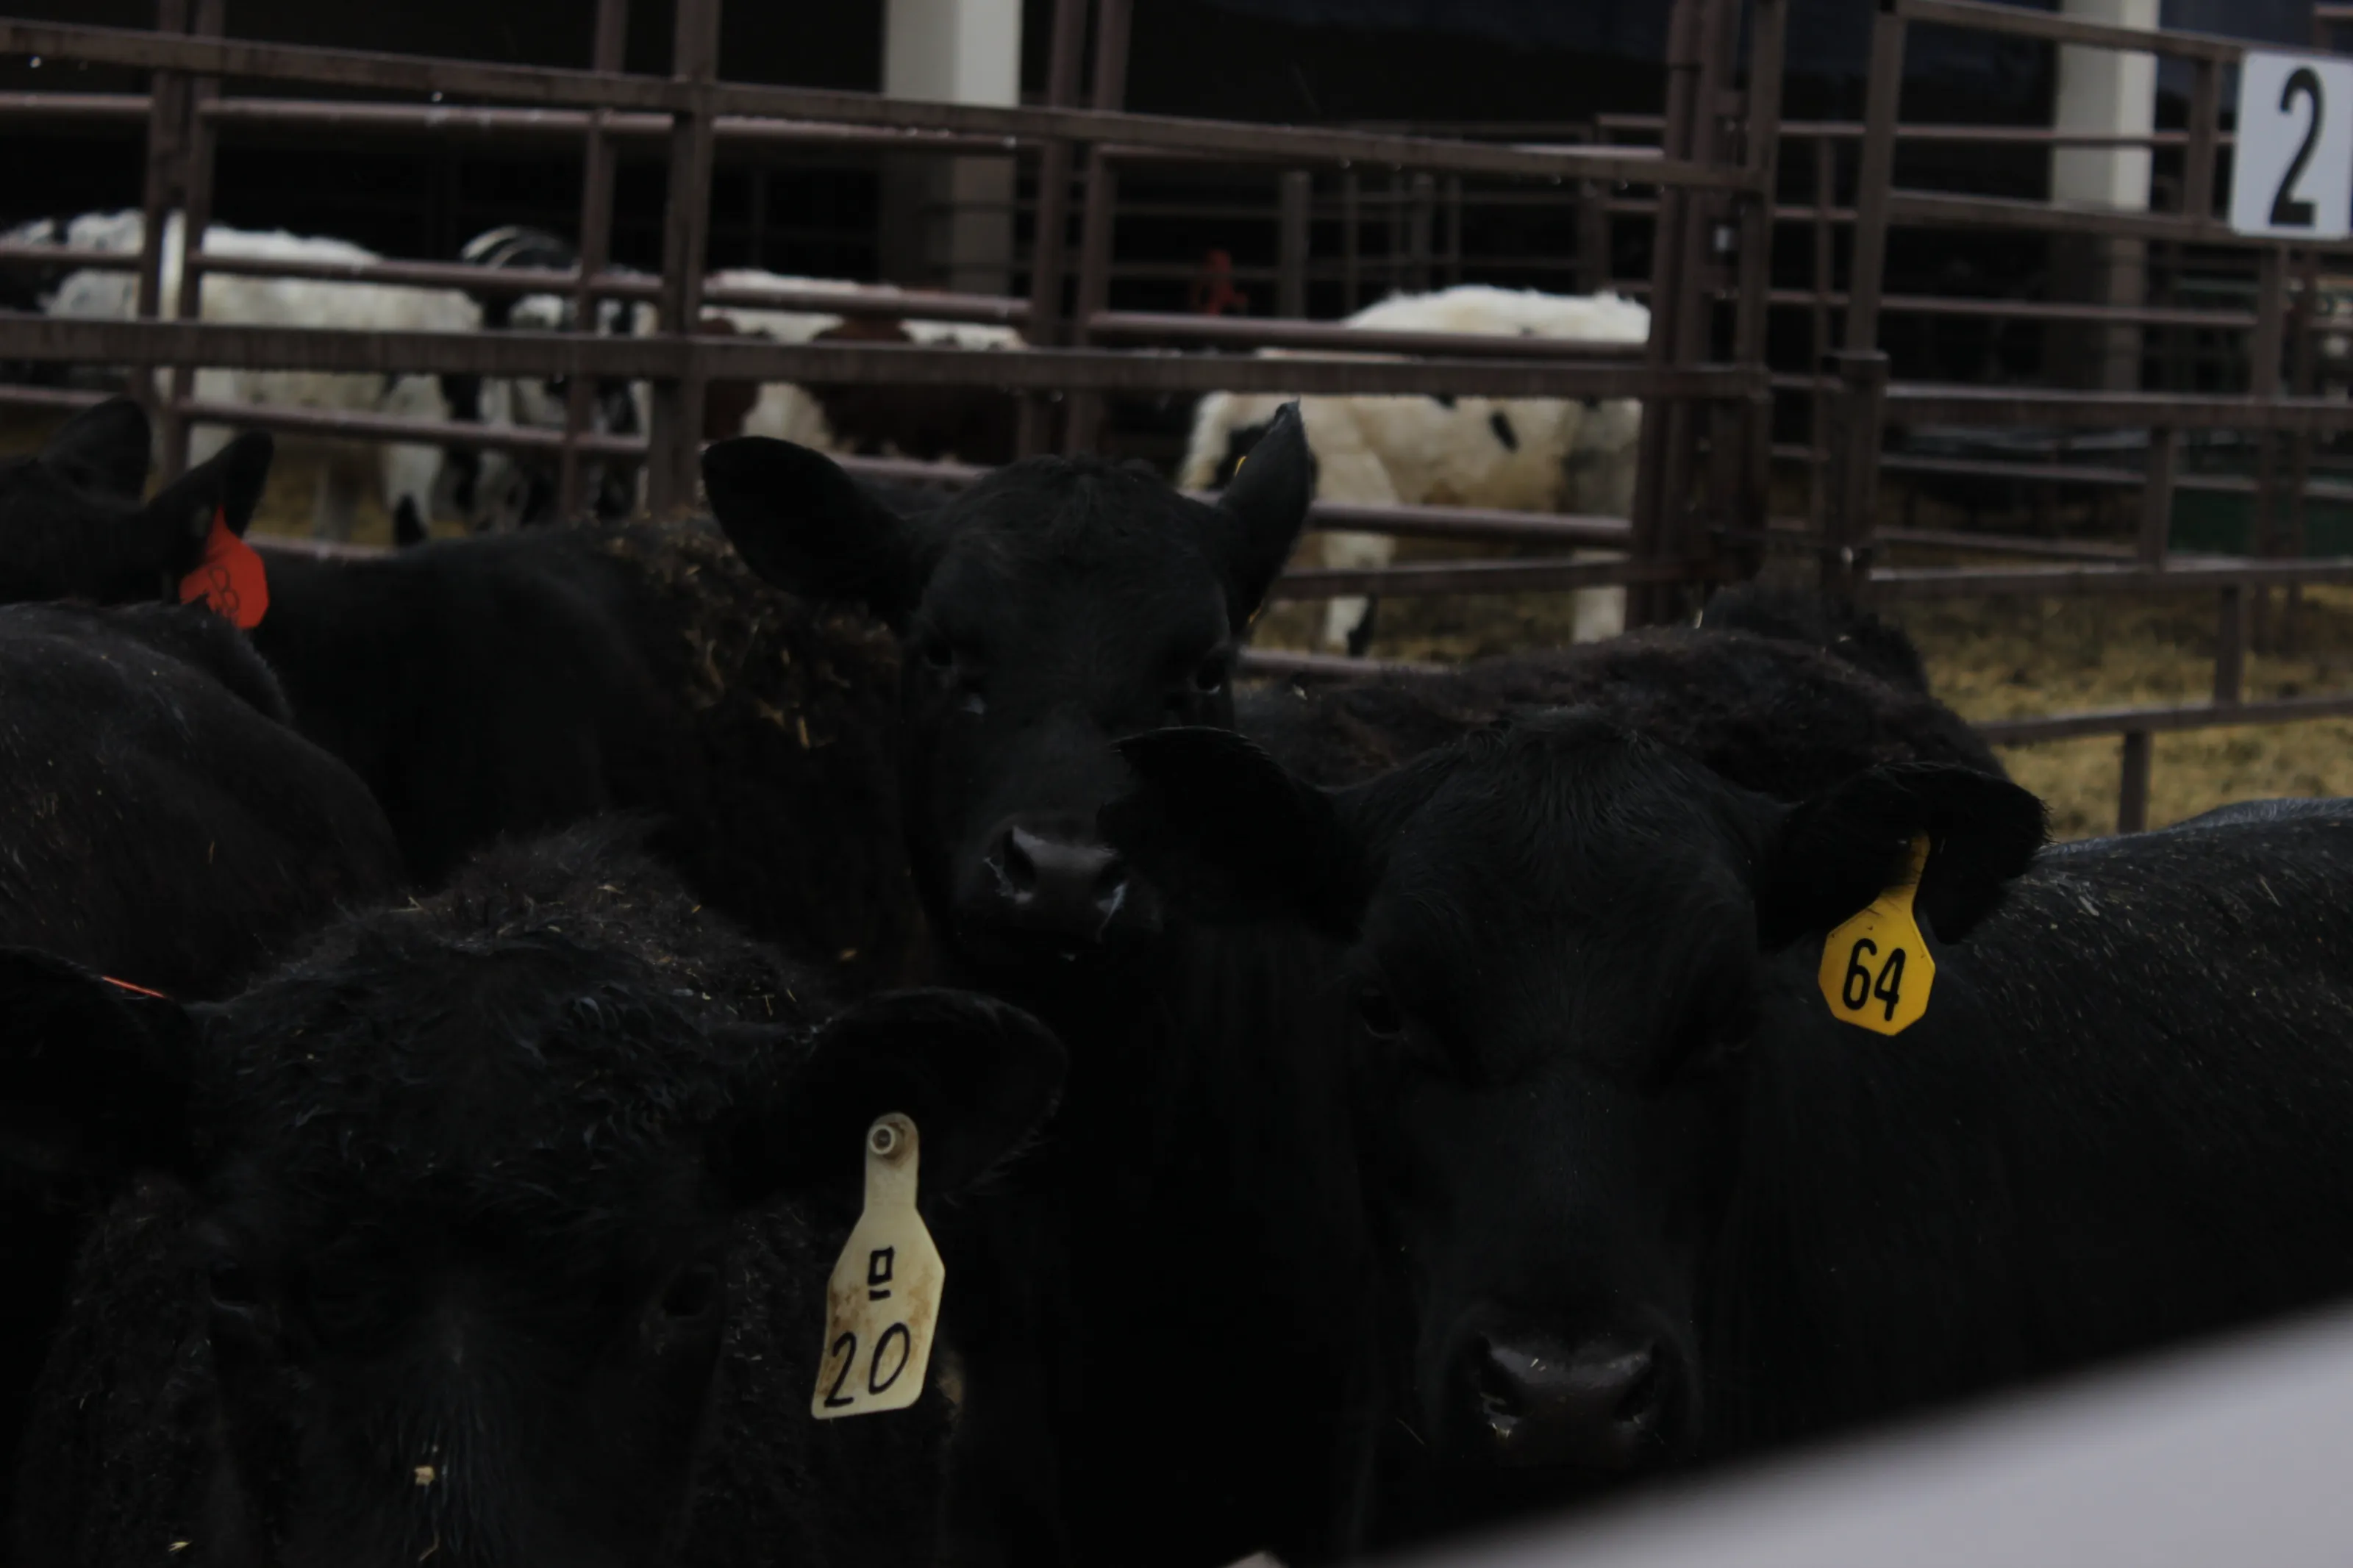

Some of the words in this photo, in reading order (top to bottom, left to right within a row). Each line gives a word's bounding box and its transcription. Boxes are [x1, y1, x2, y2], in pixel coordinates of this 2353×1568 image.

[2269, 66, 2324, 226] 2
[1842, 937, 1907, 1022] 64
[823, 1322, 911, 1408] 20
